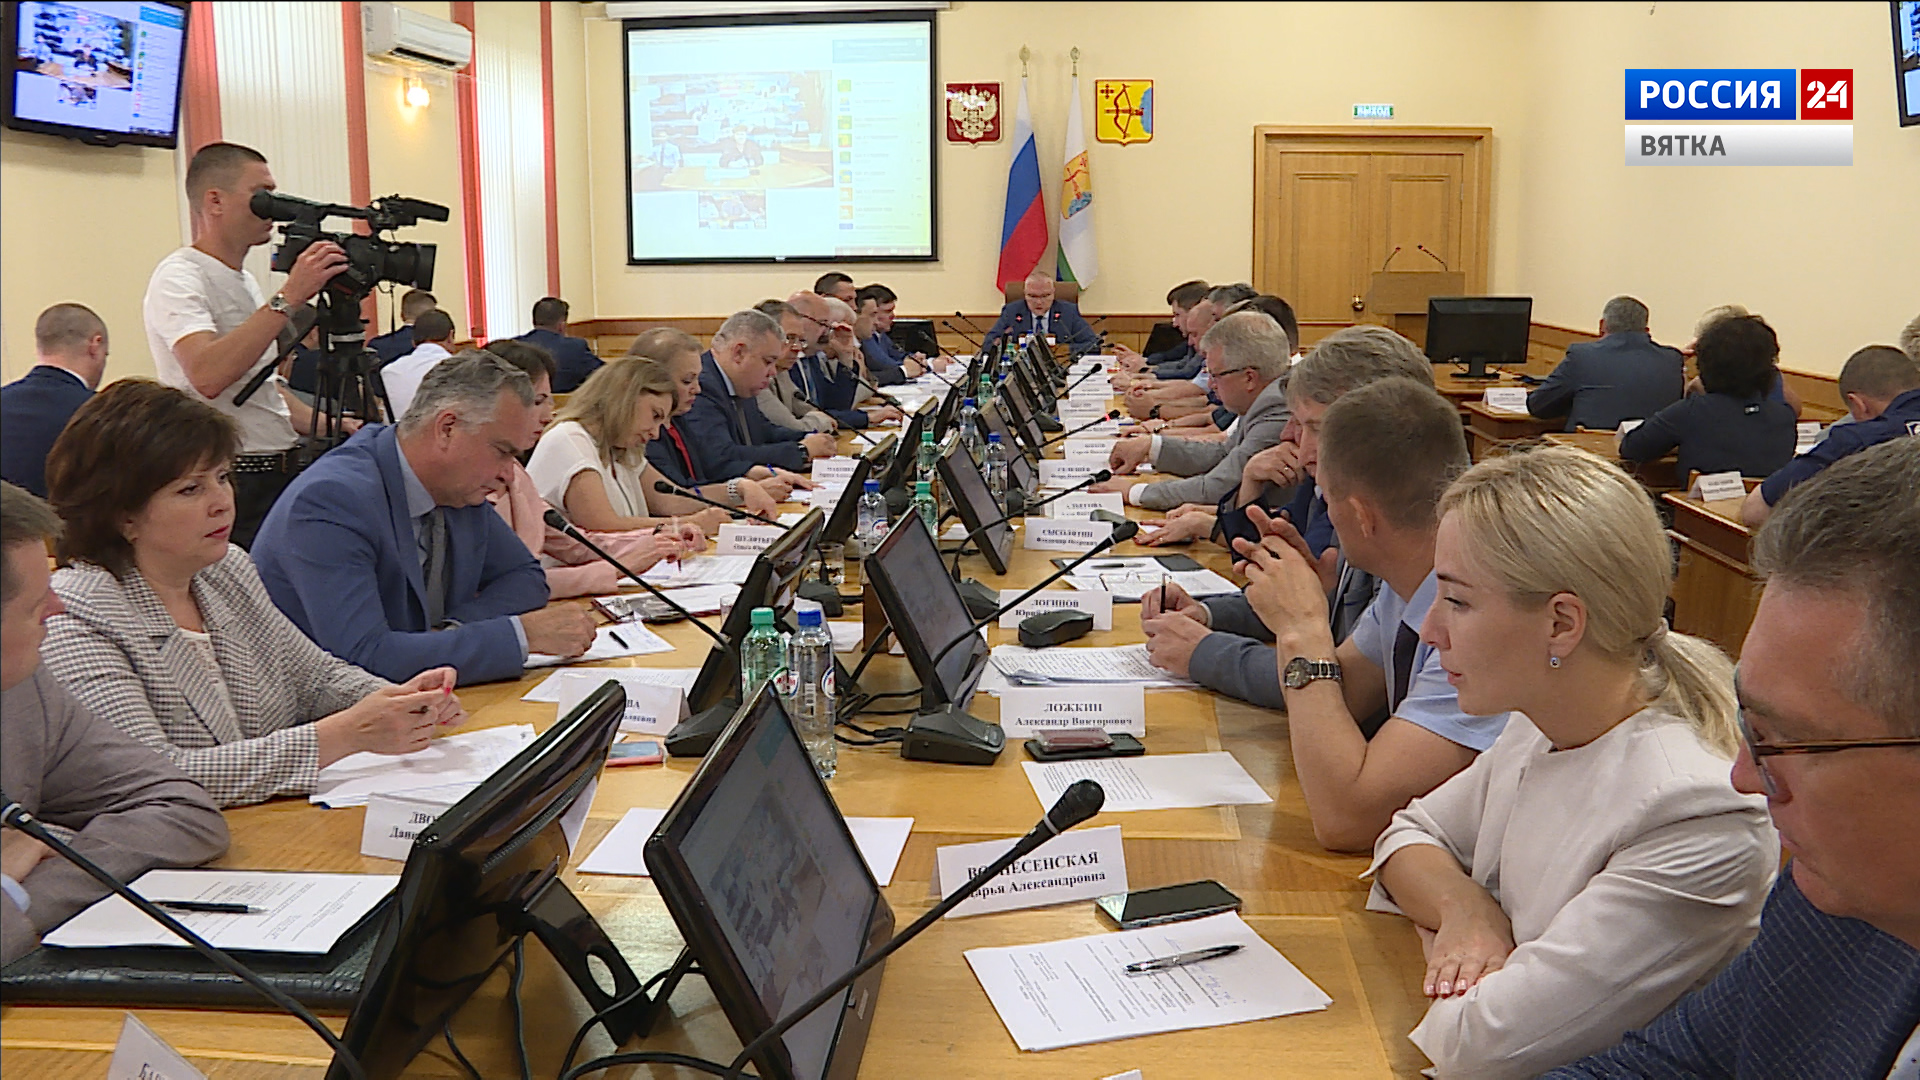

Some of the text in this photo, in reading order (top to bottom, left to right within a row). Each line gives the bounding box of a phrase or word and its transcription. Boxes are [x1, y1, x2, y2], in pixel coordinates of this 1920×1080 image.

[1031, 599, 1079, 608] ЛОГИНОВ
[1044, 703, 1103, 712] ЛОЖКИН
[1015, 717, 1132, 728] Александр Викторович
[967, 851, 1099, 880] ВОНЕСЕНСКАЯ
[1009, 872, 1106, 893] Александровна
